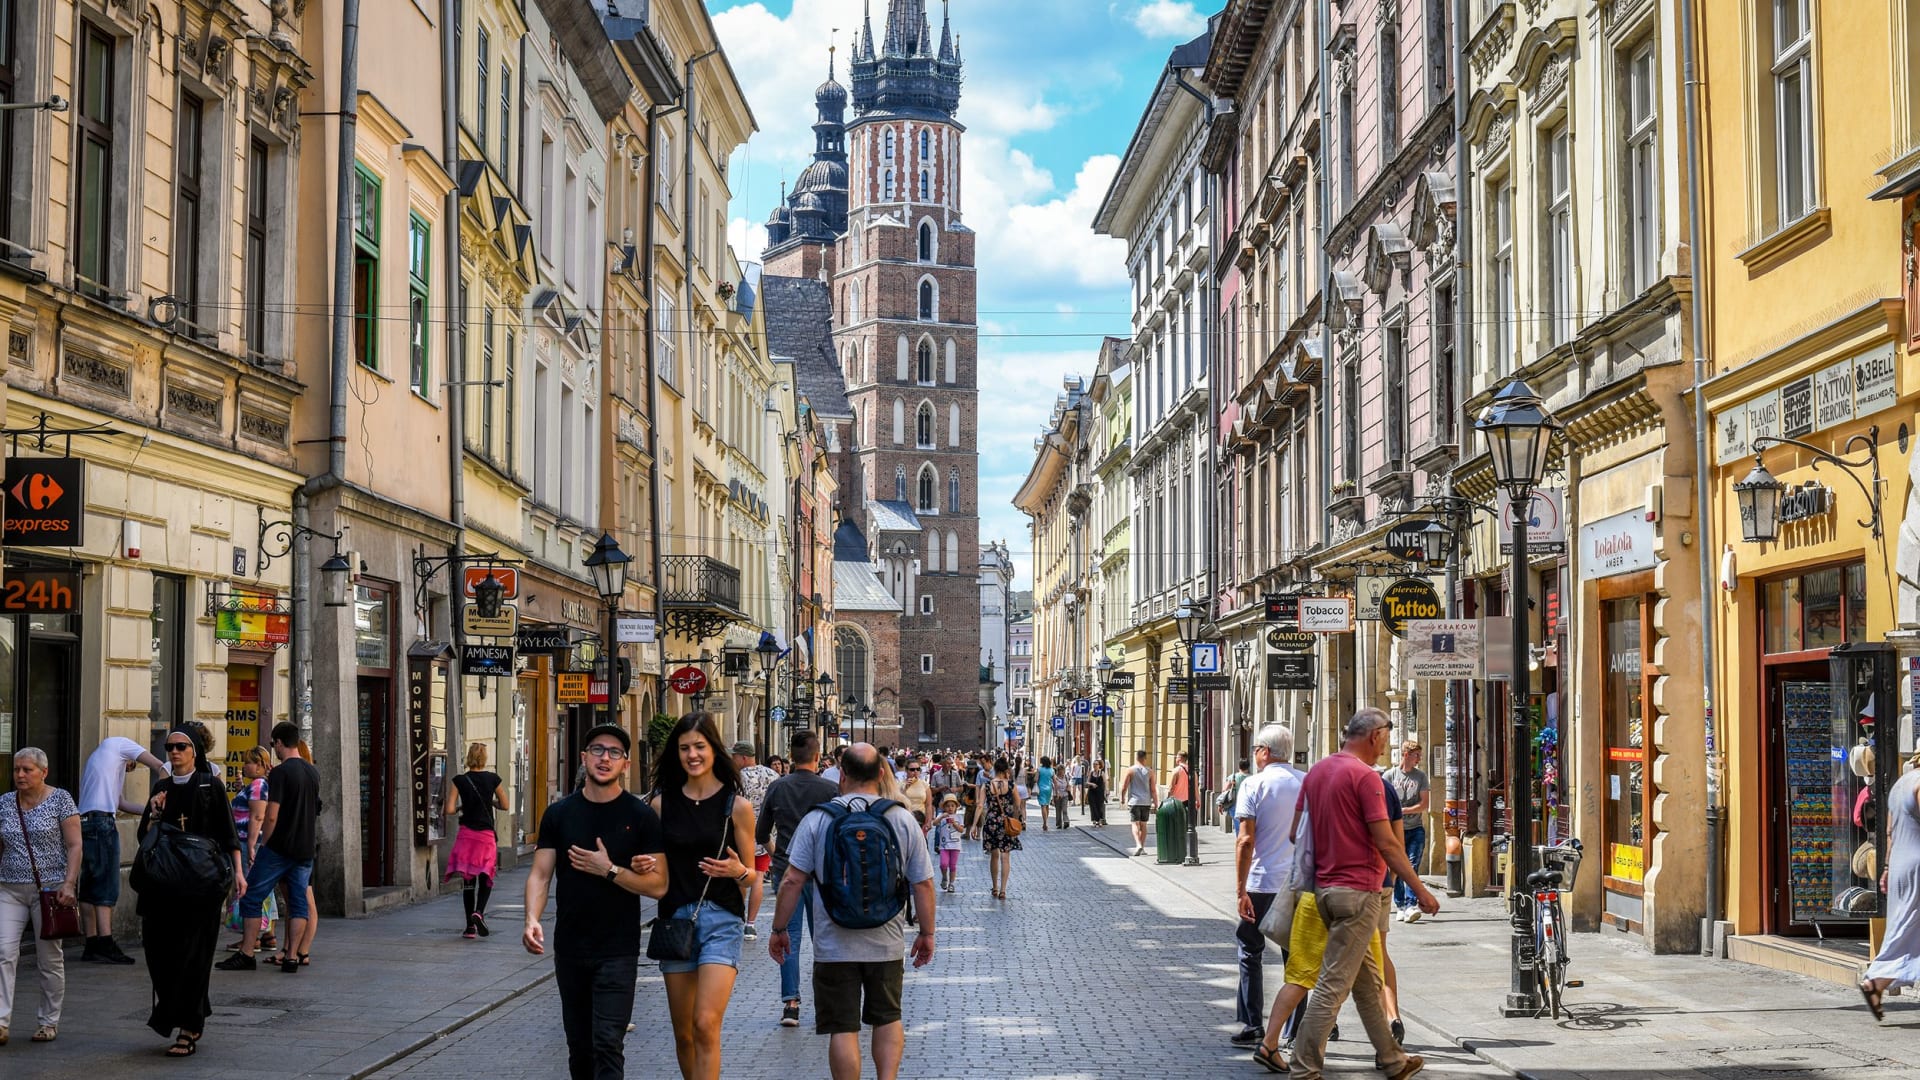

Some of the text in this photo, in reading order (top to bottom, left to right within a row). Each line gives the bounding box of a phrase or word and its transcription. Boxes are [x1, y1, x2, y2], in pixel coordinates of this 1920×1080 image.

[1865, 357, 1893, 381] 3BELL
[1817, 374, 1851, 405] TATTOO
[1783, 391, 1811, 413] HIP-HOP
[1751, 403, 1776, 429] FLAMES
[1785, 405, 1811, 431] STUFF
[1819, 398, 1851, 424] PIERCING
[4, 519, 70, 534] express
[1390, 531, 1423, 548] INTE
[1595, 532, 1632, 560] LolaLola
[1606, 555, 1623, 568] AMBER
[5, 577, 72, 609] 24h
[1392, 586, 1428, 595] piercing
[1305, 605, 1344, 616] Tobacco
[1385, 596, 1438, 618] Tattoo
[1306, 616, 1343, 627] Cigarettes
[1271, 632, 1313, 641] KANTOR
[466, 647, 509, 660] AMNESIA
[489, 666, 504, 674] club
[1078, 701, 1087, 713] P
[1055, 719, 1063, 728] P
